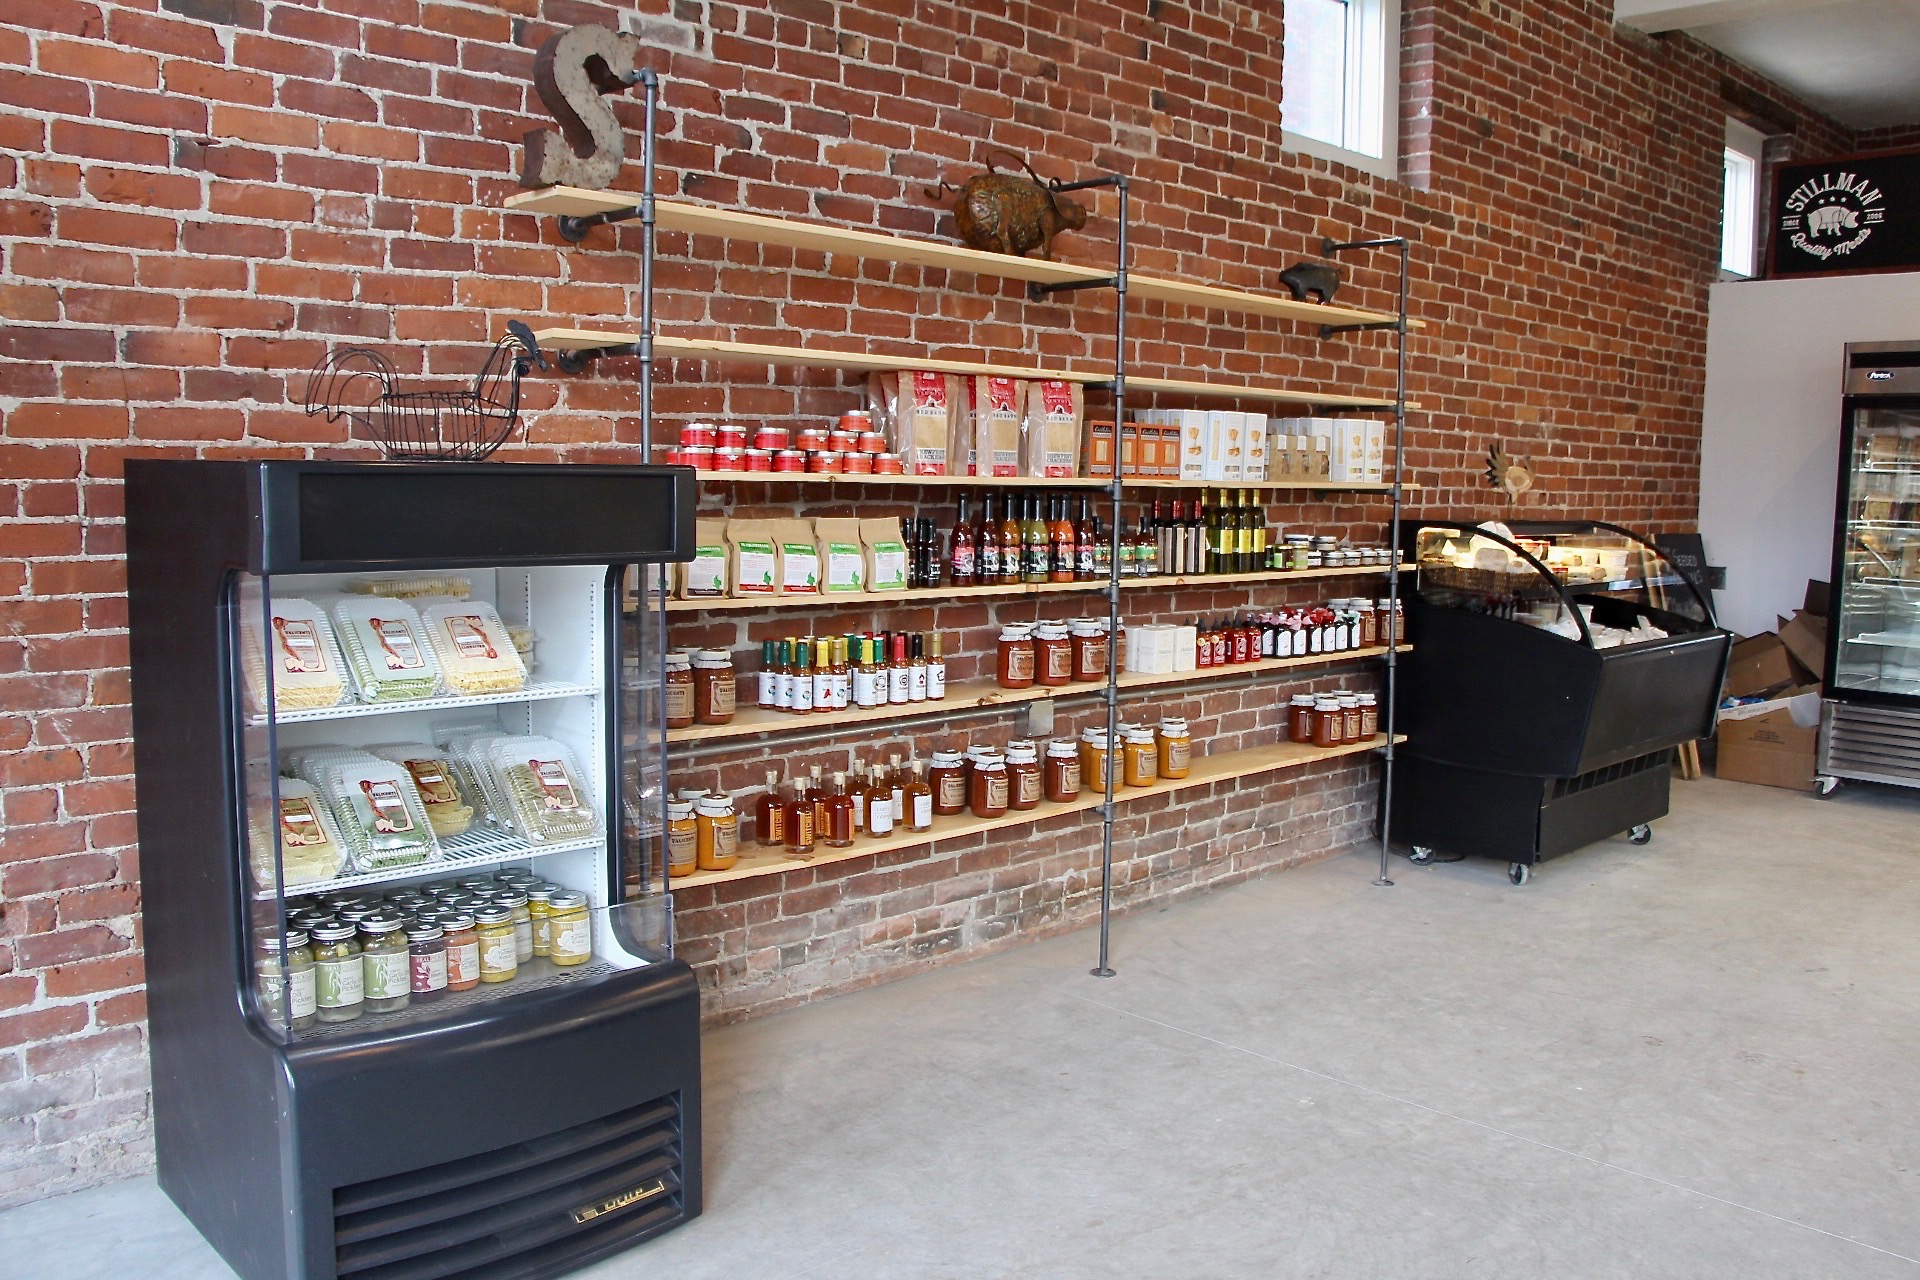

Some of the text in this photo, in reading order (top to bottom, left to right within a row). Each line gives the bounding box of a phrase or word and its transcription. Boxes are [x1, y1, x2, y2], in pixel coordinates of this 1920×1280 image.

[1785, 172, 1883, 212] STILLMAN
[1790, 228, 1872, 261] Quality Meats
[775, 807, 783, 841] SWITCHEL
